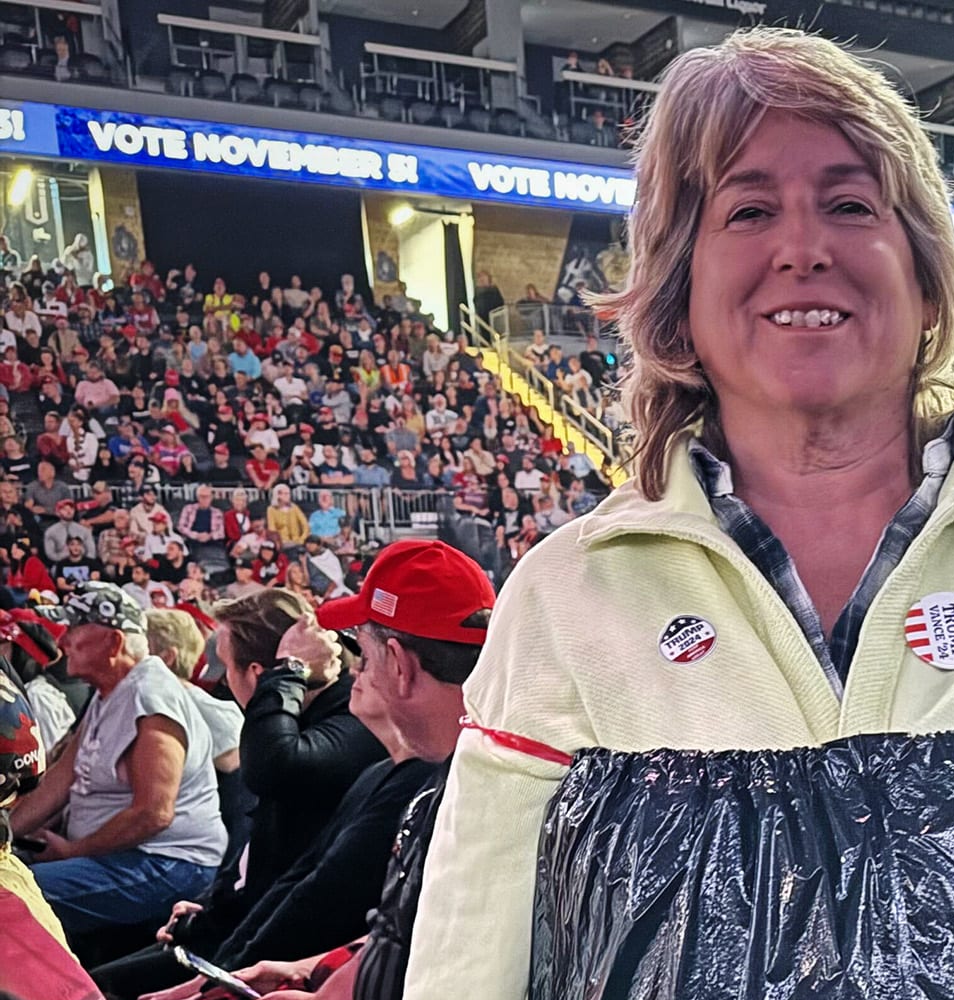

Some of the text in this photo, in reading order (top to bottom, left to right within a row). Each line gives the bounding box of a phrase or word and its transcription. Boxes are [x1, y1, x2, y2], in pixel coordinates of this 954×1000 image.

[87, 121, 419, 184] VOTE NOVEMBER 5!
[467, 162, 638, 206] VOTE NOVE
[664, 623, 705, 649] TRUMP
[678, 634, 702, 651] 2024
[929, 604, 949, 660] VANCE '24
